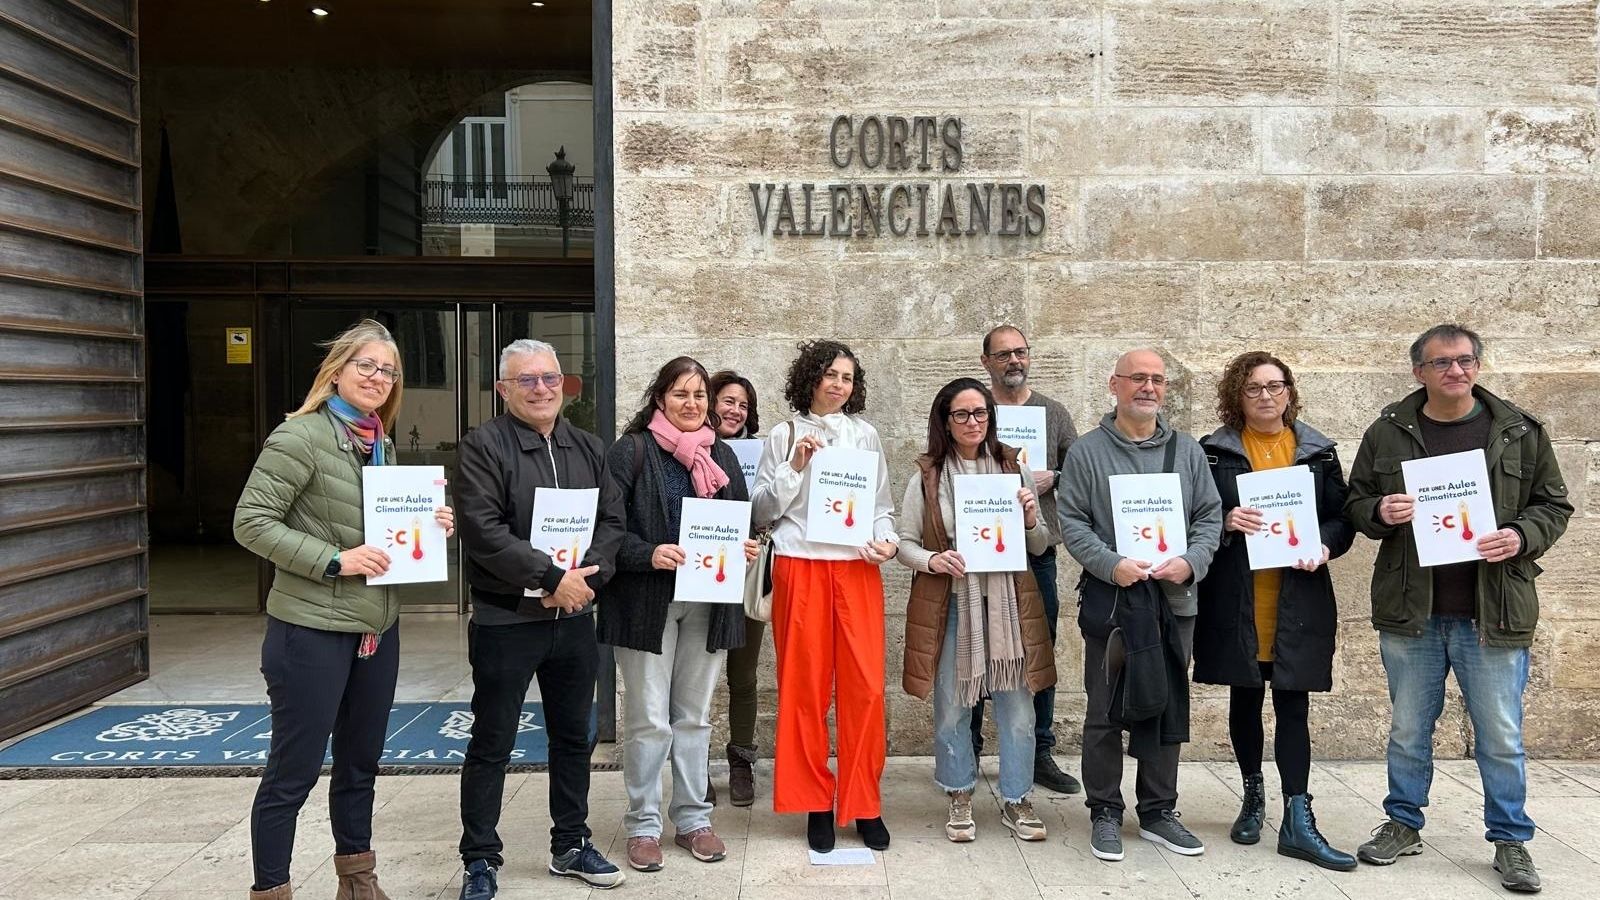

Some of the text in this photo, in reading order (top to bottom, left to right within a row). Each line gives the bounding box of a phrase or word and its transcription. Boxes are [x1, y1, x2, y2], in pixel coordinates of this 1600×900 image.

[829, 114, 963, 171] CORTS
[749, 182, 1046, 237] VALENCIANES
[844, 472, 867, 482] Aules
[1448, 480, 1476, 490] Aules
[405, 494, 433, 503] Aules
[1275, 491, 1302, 500] Aules
[1418, 489, 1478, 502] Climatitzades
[988, 497, 1012, 506] Aules
[1147, 497, 1173, 505] Aules
[569, 516, 590, 525] Aules
[715, 525, 739, 534] Aules
[51, 750, 200, 761] CORTS
